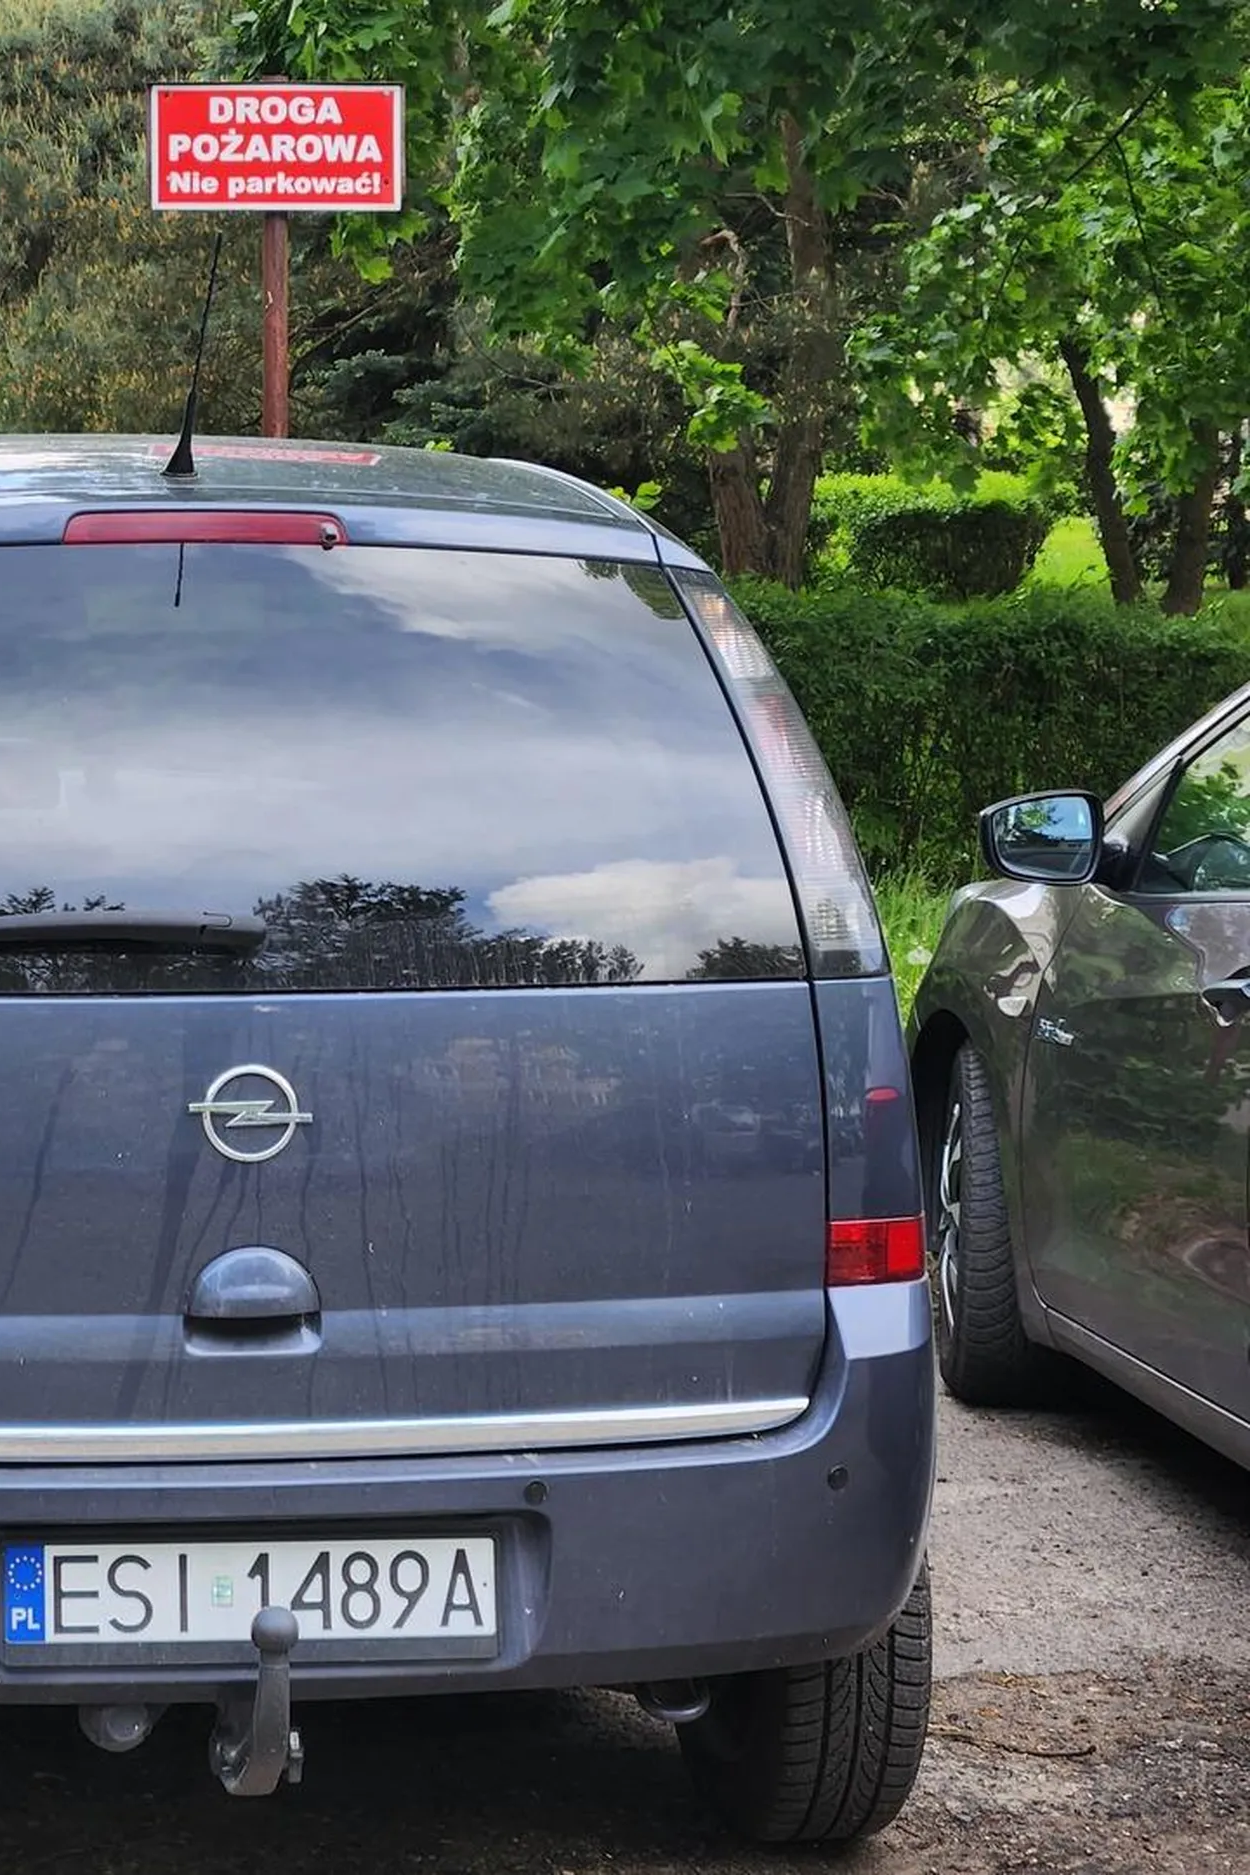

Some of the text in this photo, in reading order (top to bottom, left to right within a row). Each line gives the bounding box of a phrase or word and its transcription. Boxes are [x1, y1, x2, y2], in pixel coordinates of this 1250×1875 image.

[209, 96, 343, 124] DROGA
[168, 128, 383, 162] POŻAROWA
[167, 171, 382, 198] Nie parkować!
[53, 1549, 484, 1635] ESI 1489A
[11, 1607, 41, 1630] PL
